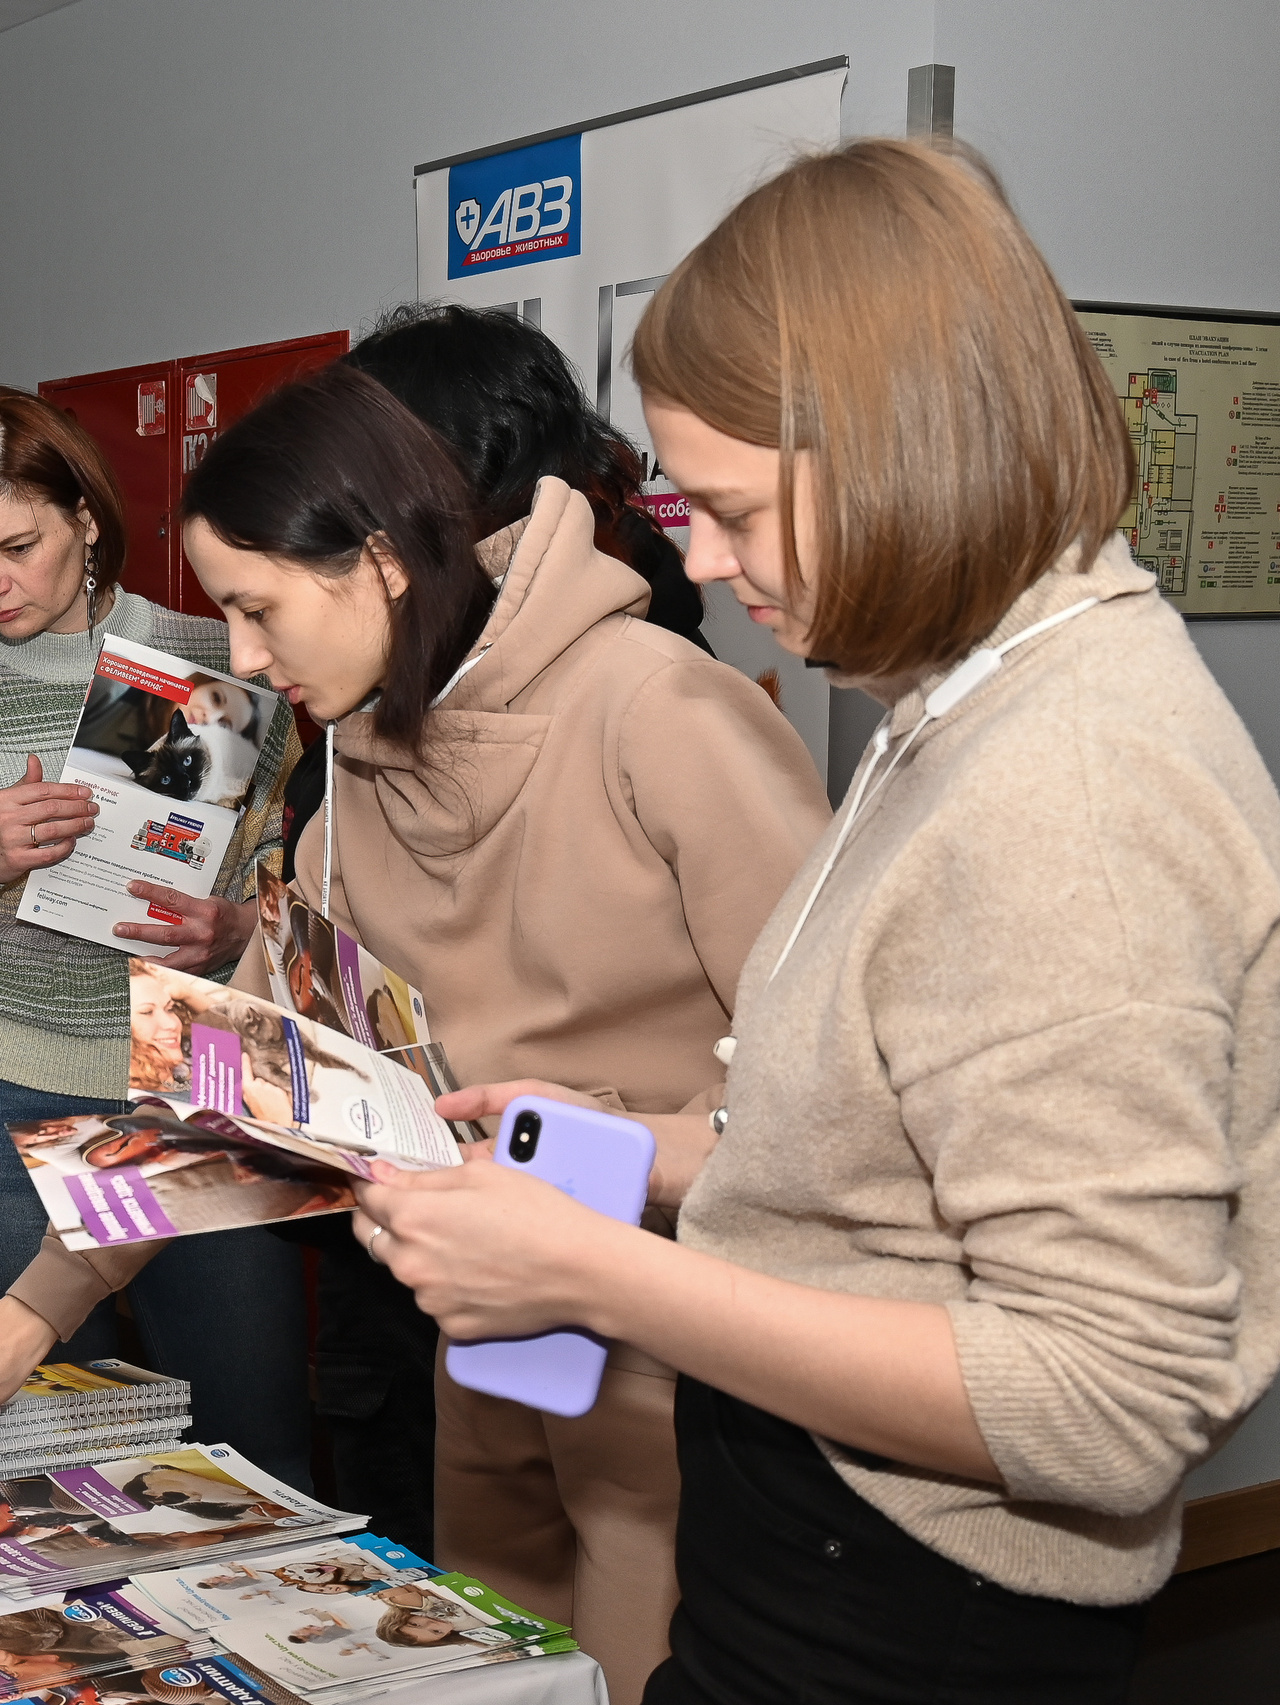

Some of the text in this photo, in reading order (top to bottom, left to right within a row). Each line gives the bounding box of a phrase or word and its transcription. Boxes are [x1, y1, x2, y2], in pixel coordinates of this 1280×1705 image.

[470, 176, 573, 250] АВЗ
[471, 236, 563, 262] здоровье животных
[659, 498, 691, 522] соба
